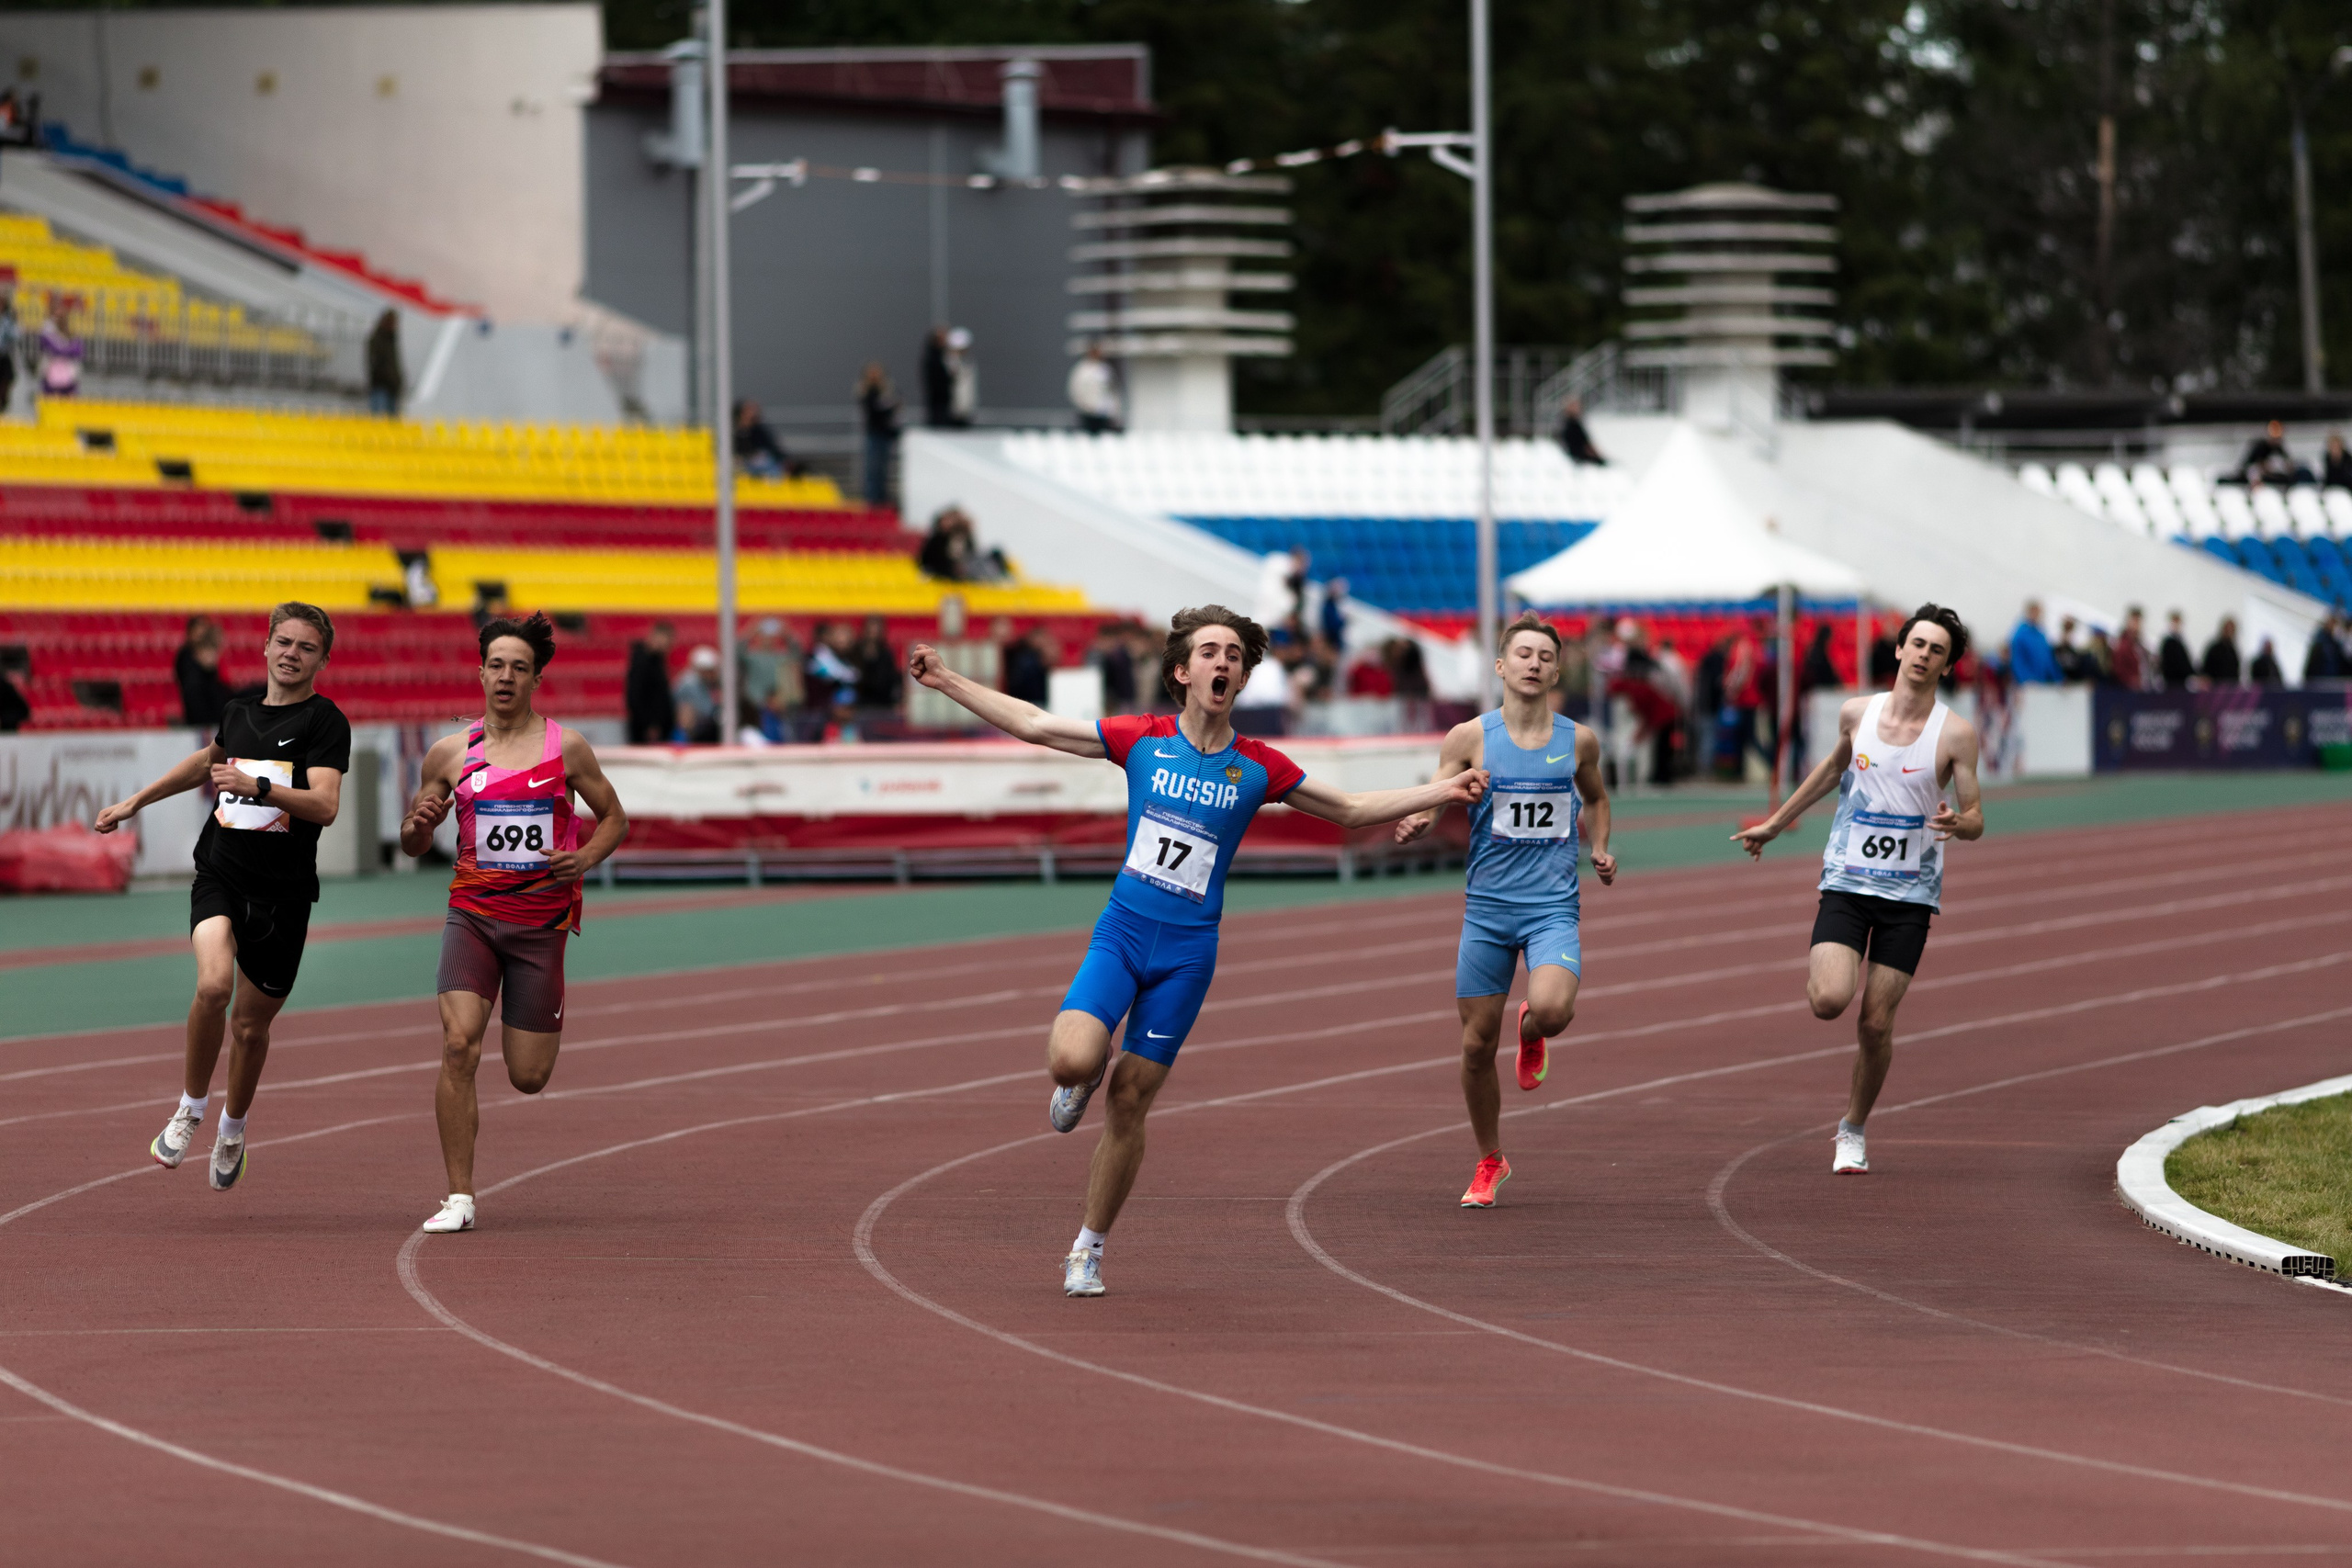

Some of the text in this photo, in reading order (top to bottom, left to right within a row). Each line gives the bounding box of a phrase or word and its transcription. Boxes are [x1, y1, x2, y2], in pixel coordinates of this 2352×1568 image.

[1151, 768, 1238, 810] RUSSIA
[1146, 809, 1196, 831] ФЕДЕРАЛЬНОГО
[1510, 802, 1554, 828] 112
[487, 824, 543, 852] 698
[1861, 835, 1908, 861] 691
[1156, 837, 1193, 871] 17
[1149, 877, 1171, 890] ВФЛА
